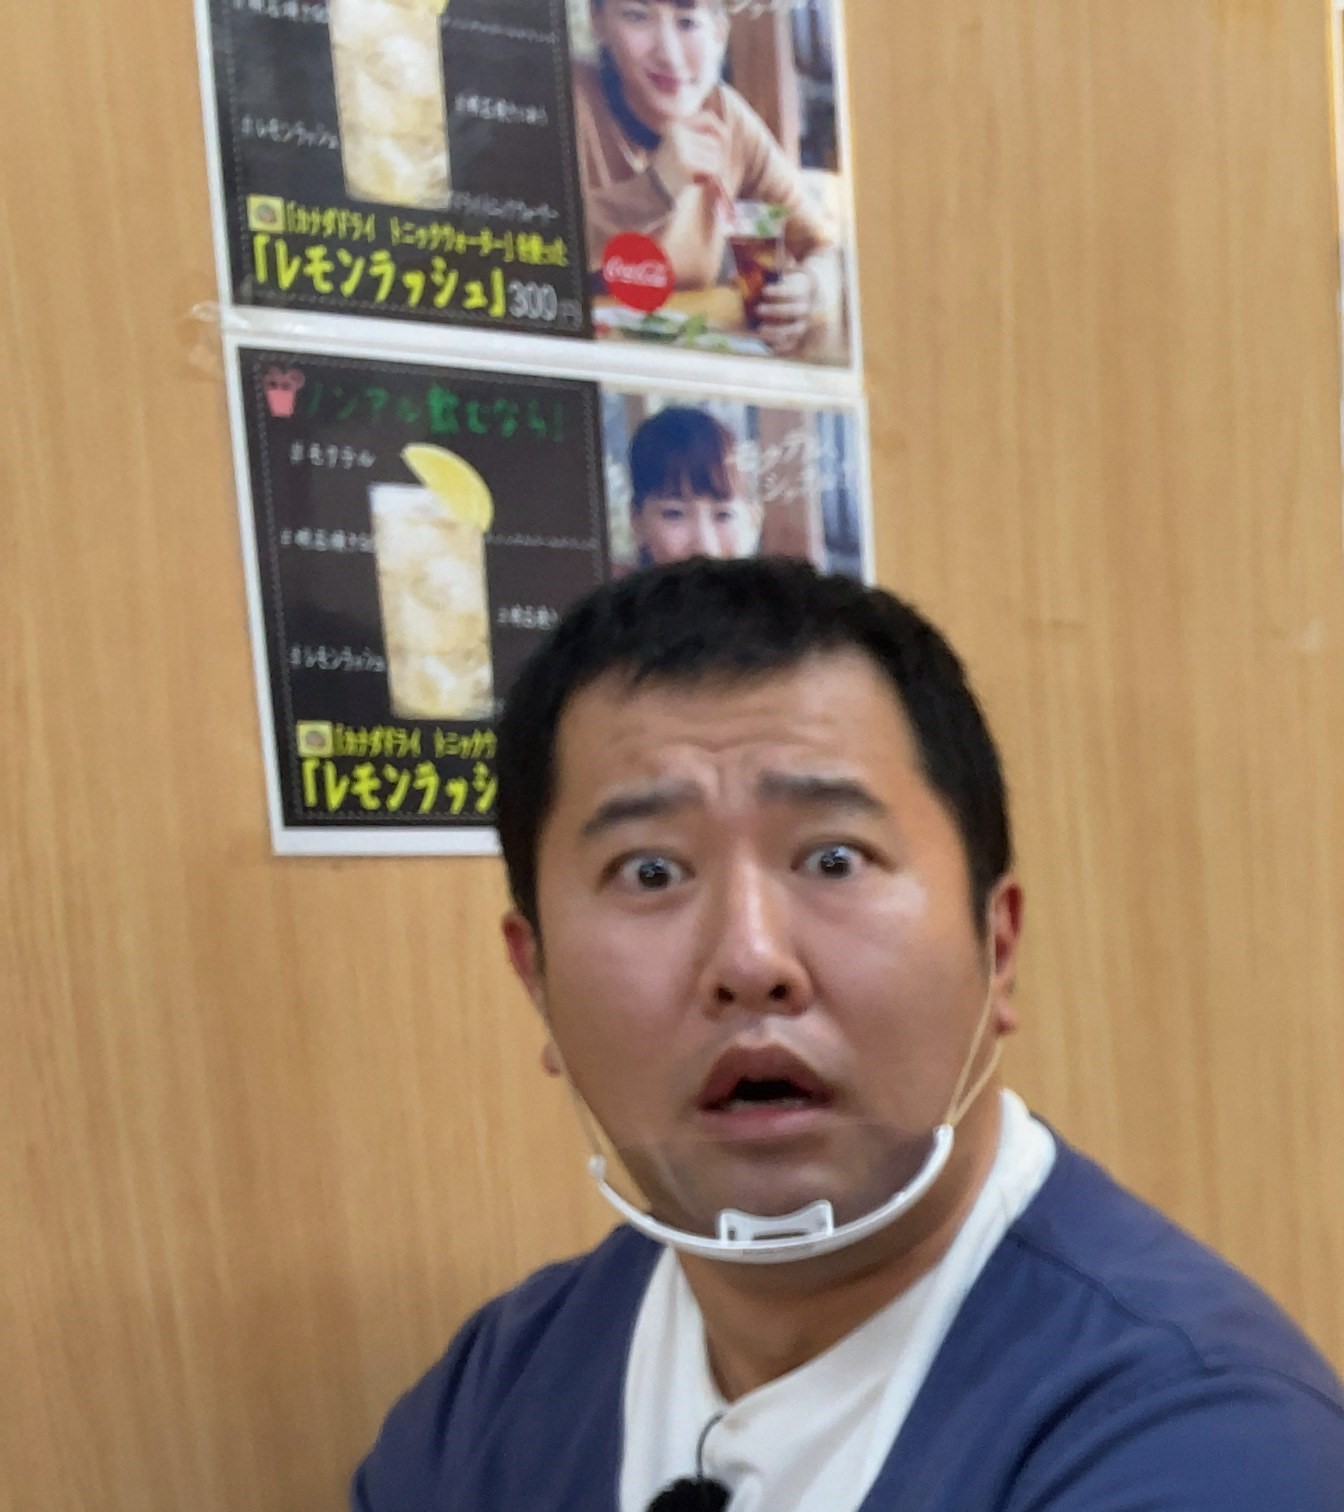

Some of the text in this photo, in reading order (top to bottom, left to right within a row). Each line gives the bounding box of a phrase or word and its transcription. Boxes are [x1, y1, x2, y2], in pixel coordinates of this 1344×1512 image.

[253, 233, 506, 318] 「レモンラッシュ」
